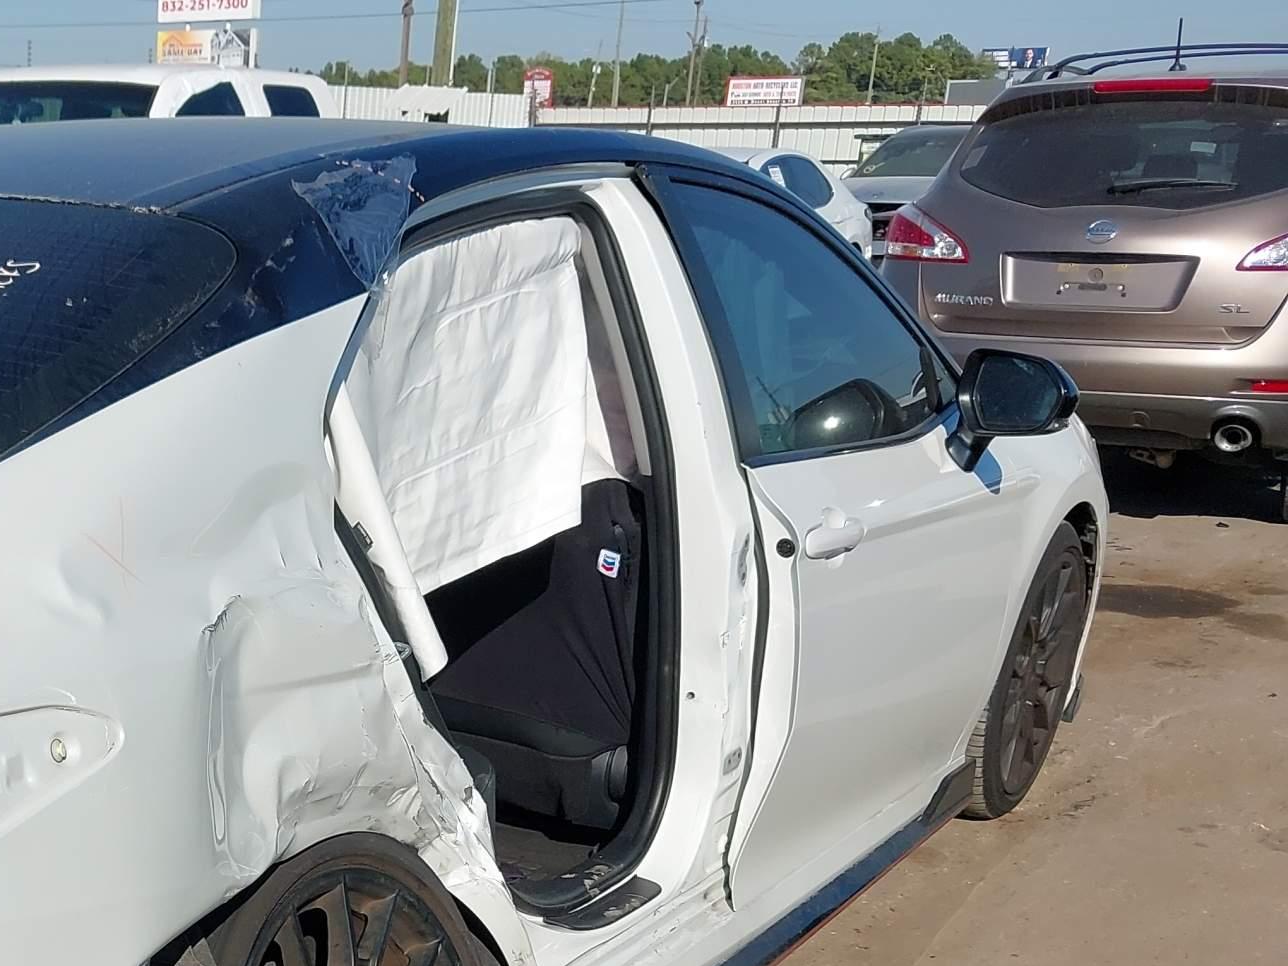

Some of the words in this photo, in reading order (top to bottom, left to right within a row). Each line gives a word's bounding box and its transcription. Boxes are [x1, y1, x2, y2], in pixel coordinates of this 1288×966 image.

[161, 0, 249, 12] 832-251-7300
[934, 293, 994, 306] MURANO
[1218, 303, 1251, 314] SL
